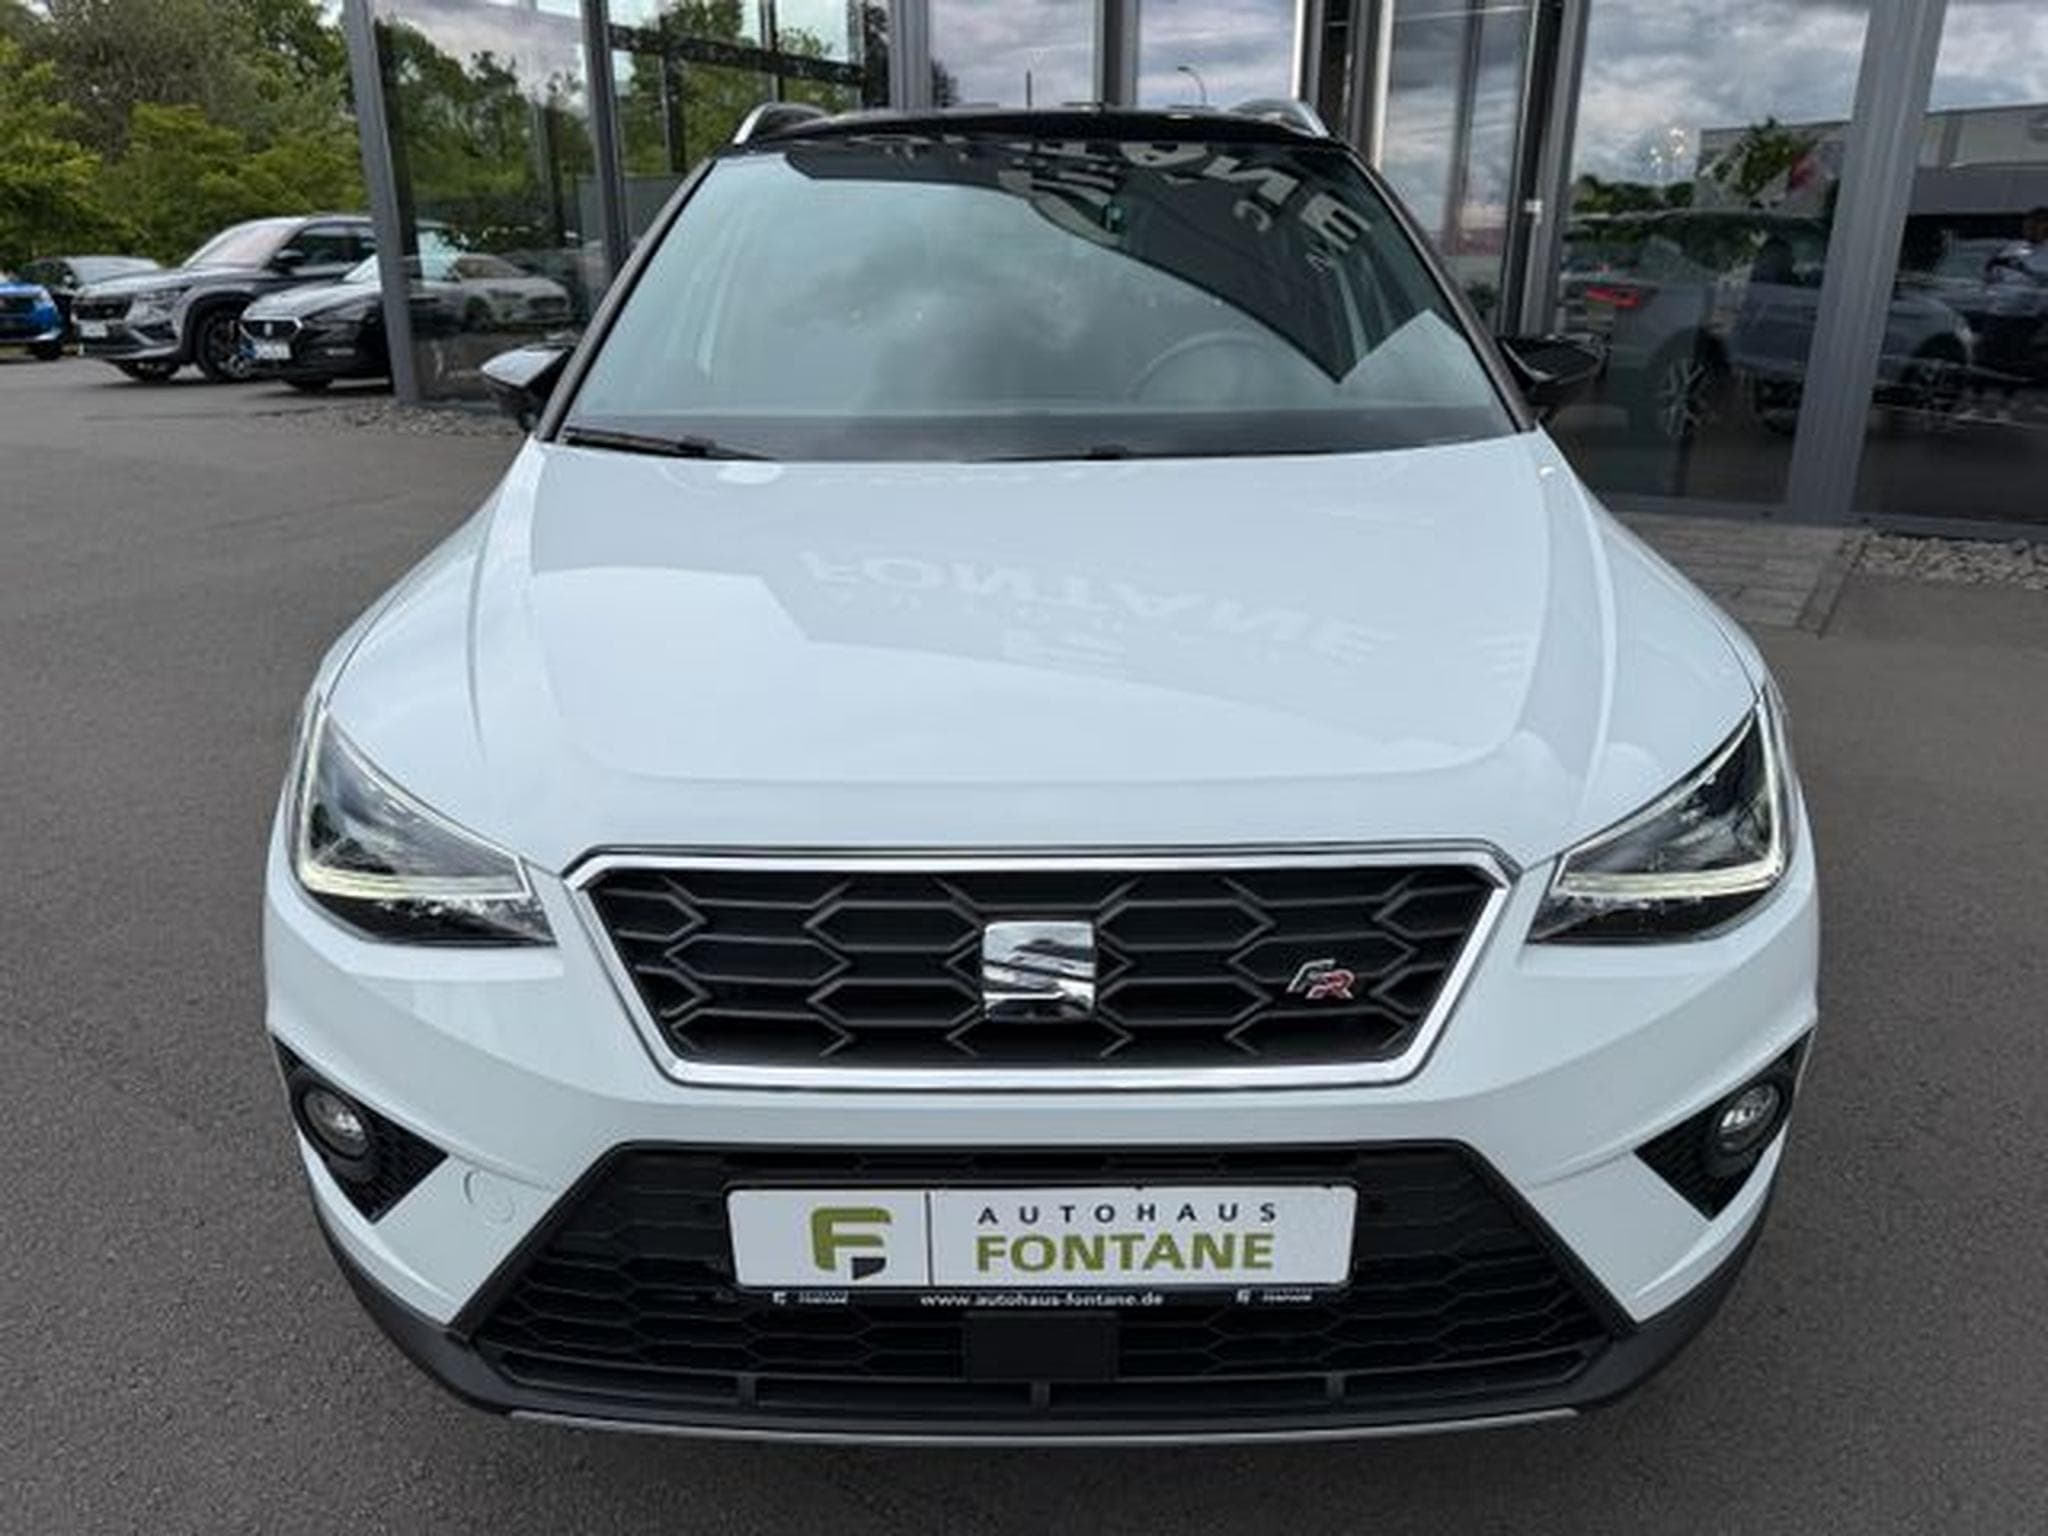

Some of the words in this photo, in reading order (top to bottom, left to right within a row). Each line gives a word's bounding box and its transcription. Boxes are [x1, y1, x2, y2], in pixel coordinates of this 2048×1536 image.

[1286, 958, 1355, 999] FR
[977, 1203, 1276, 1224] AUTOHAUS
[976, 1233, 1274, 1271] FONTANE
